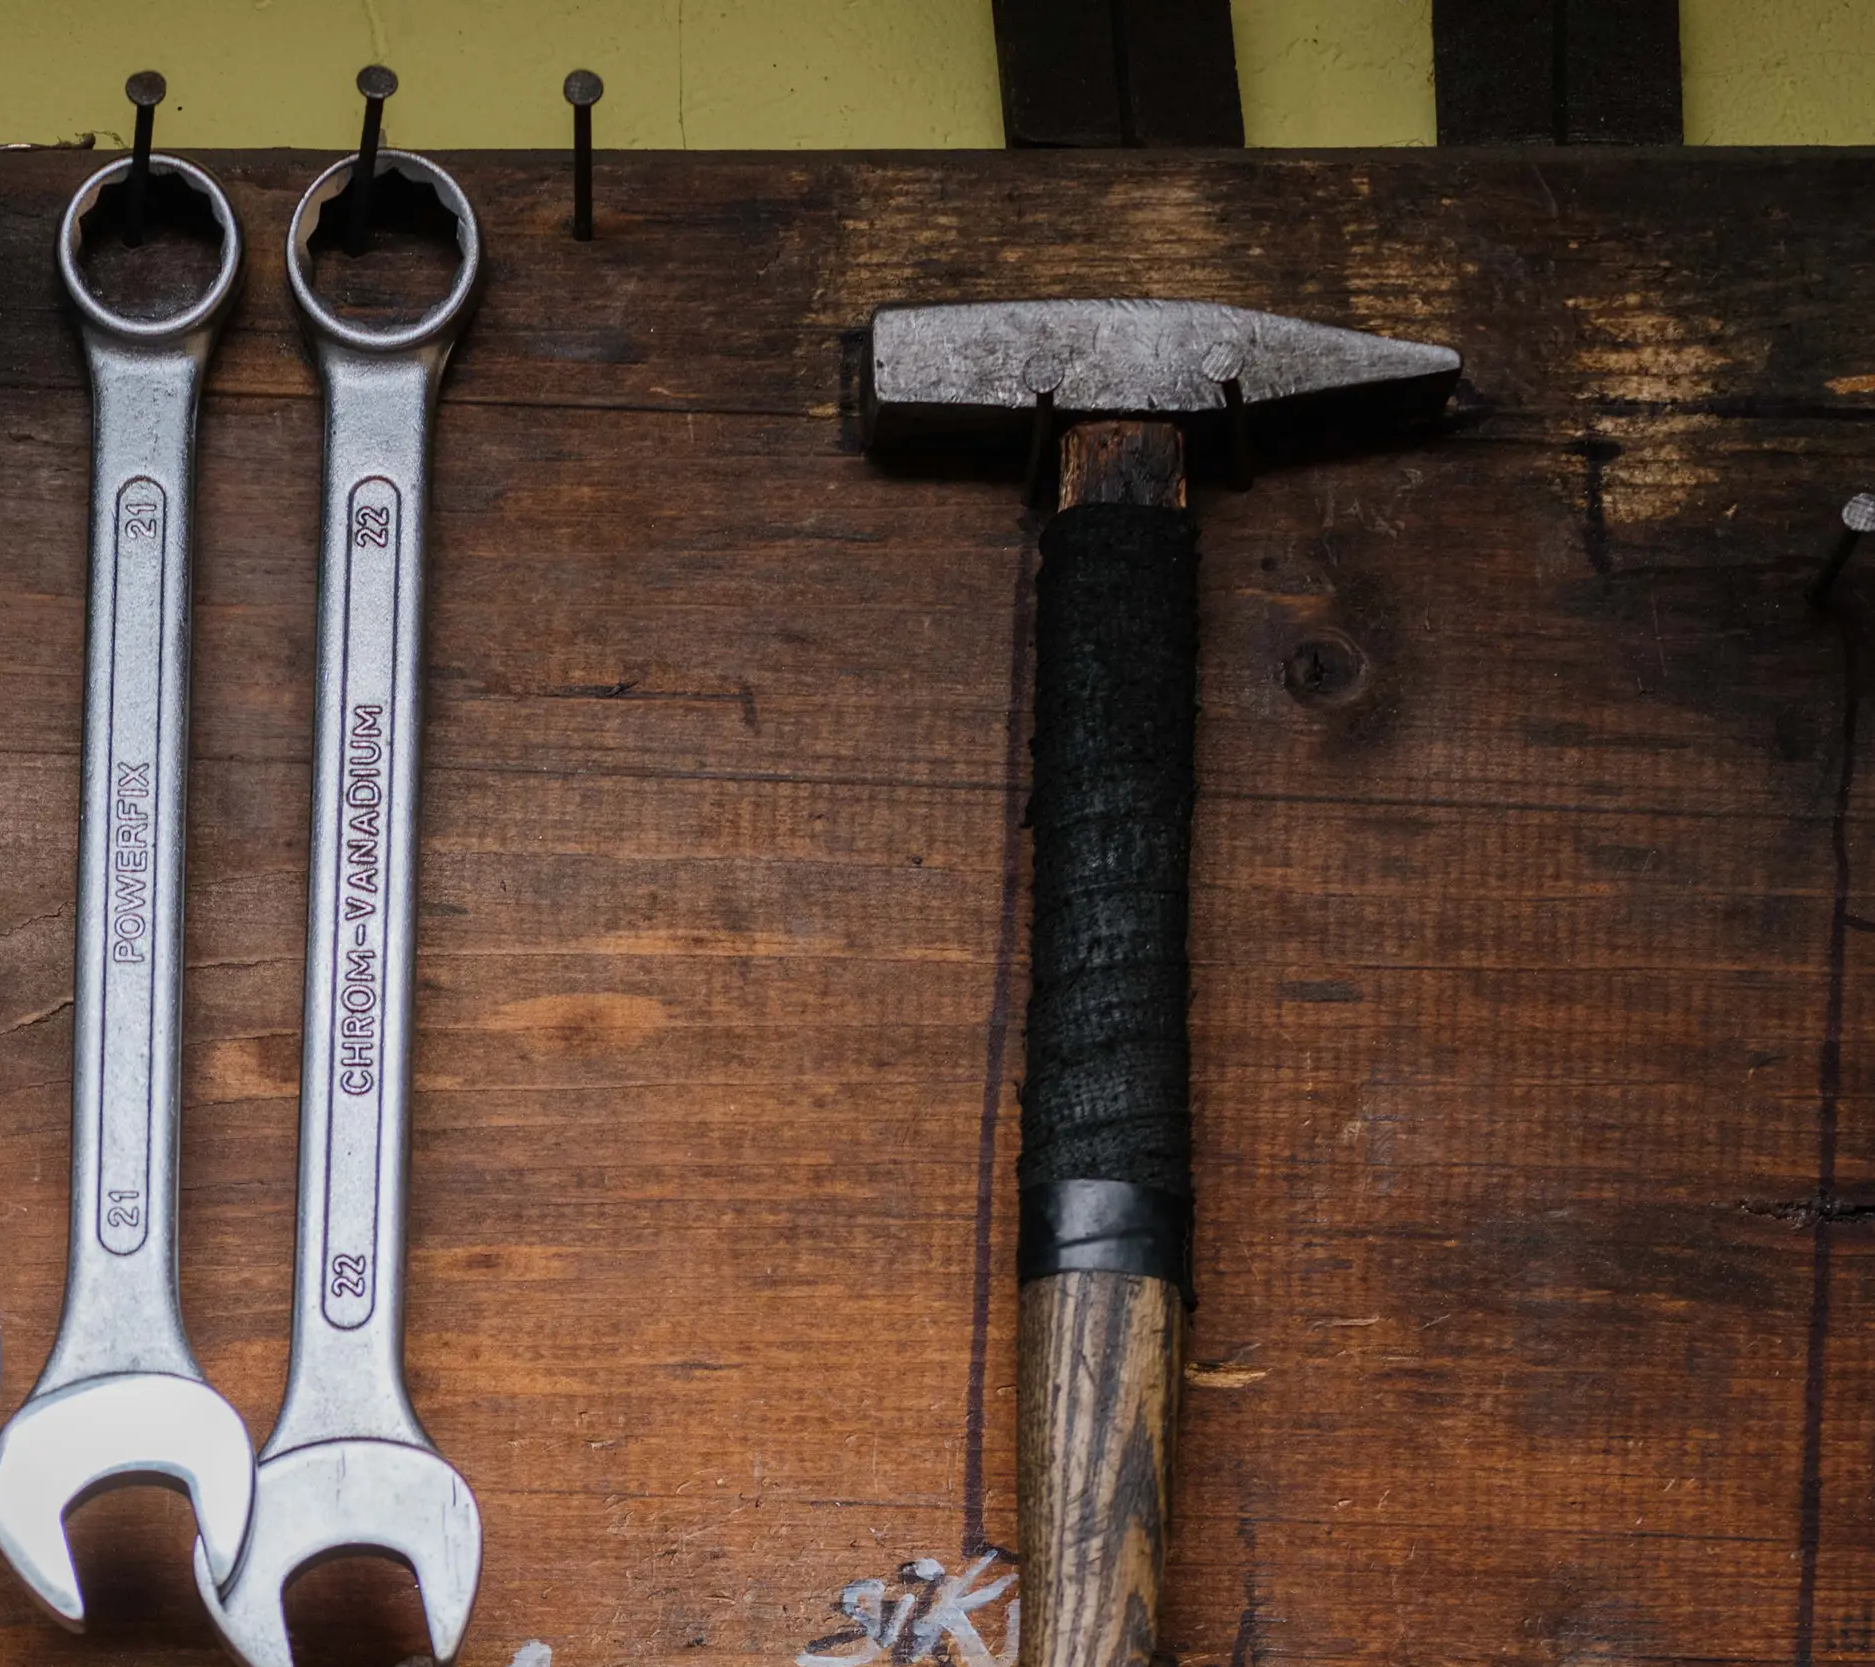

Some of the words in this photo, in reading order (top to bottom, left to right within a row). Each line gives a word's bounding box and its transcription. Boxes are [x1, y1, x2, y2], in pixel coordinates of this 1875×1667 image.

[125, 501, 157, 539] 21
[355, 505, 390, 549] 22
[113, 761, 149, 965] POWERFIX
[338, 703, 384, 1097] CHROM-VANADIUM
[107, 1188, 139, 1228] 21
[331, 1254, 367, 1297] 22
